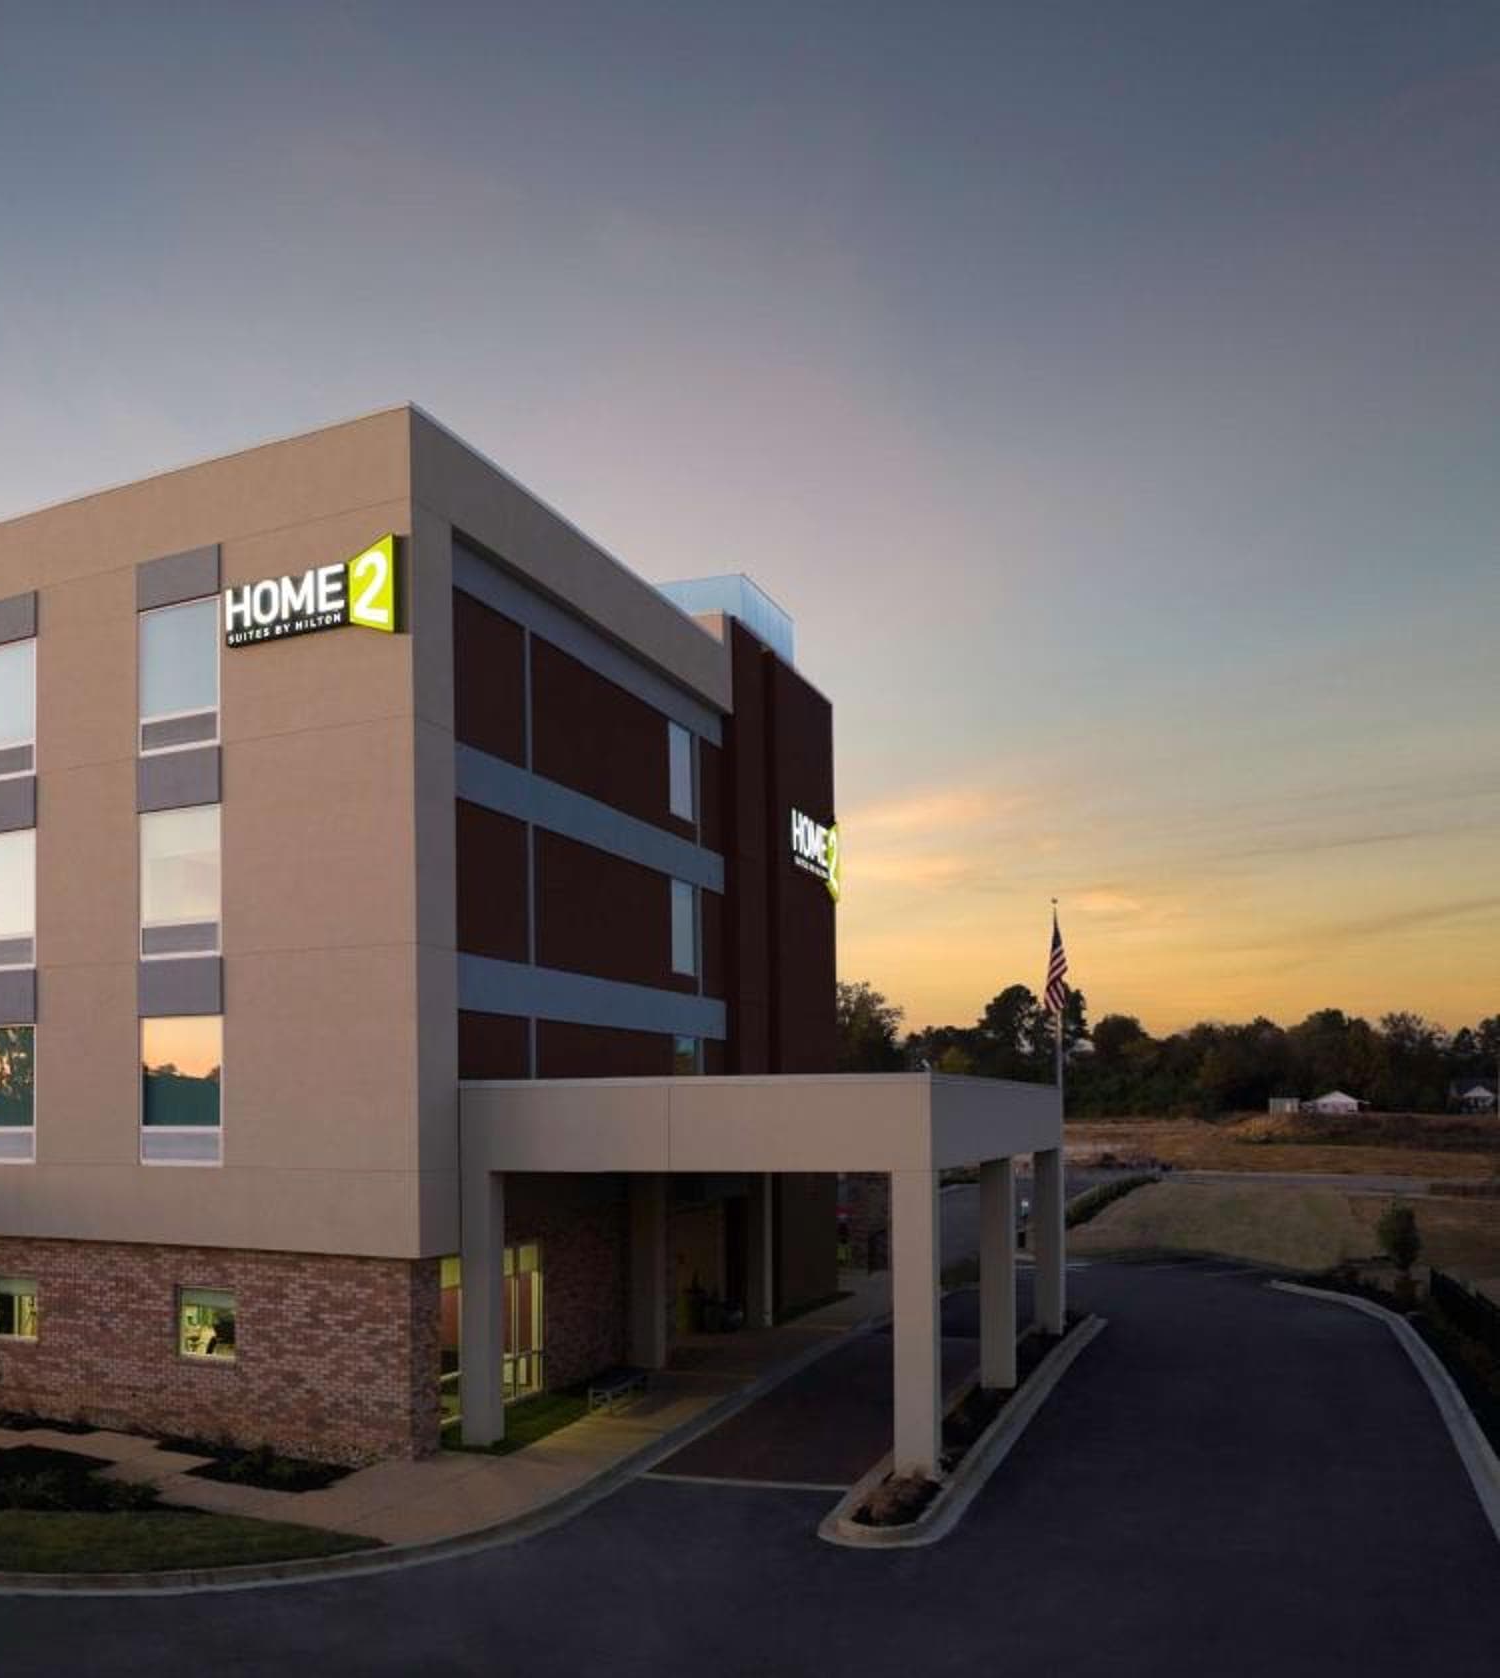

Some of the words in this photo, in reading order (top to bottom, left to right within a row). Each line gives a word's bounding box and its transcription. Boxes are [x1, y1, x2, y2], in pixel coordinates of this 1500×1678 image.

[225, 563, 345, 631] HOME
[354, 550, 389, 623] 2
[228, 628, 270, 644] SUITES
[275, 623, 291, 636] BY
[295, 613, 342, 630] HILTON
[791, 808, 828, 868] HOME
